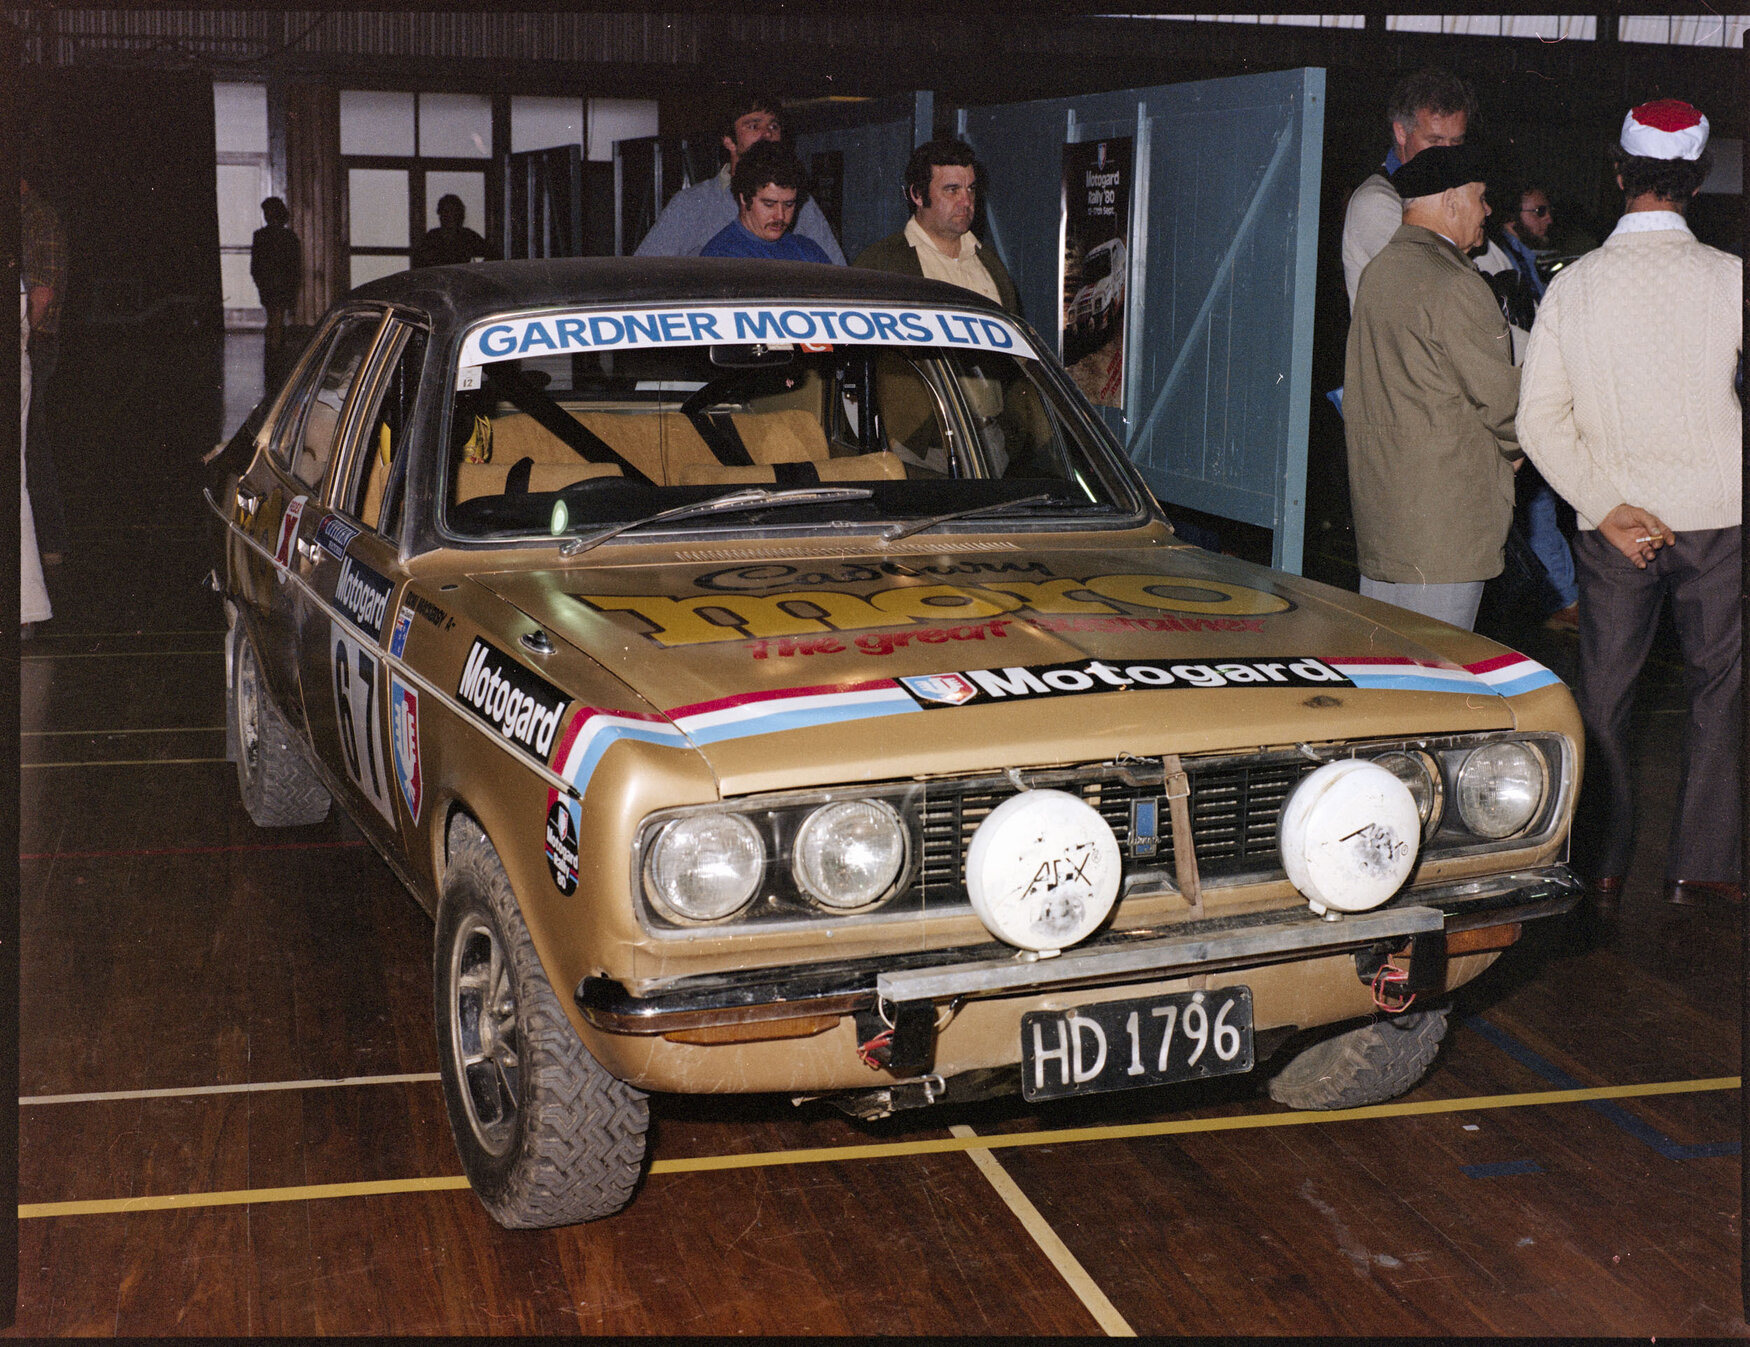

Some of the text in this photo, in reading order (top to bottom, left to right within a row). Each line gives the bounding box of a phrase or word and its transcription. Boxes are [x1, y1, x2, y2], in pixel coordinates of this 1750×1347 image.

[1086, 170, 1120, 188] Motogard
[479, 310, 1013, 357] GARDNER MOTORS LTD
[335, 556, 391, 630] Motogard
[693, 561, 1055, 591] Cadbury
[563, 574, 1298, 649] moro
[854, 620, 1013, 656] great
[459, 641, 565, 757] Motogard
[965, 658, 1349, 698] Motogard
[335, 639, 382, 801] 67
[546, 825, 579, 870] Motogard
[1032, 998, 1241, 1089] HD 1796
